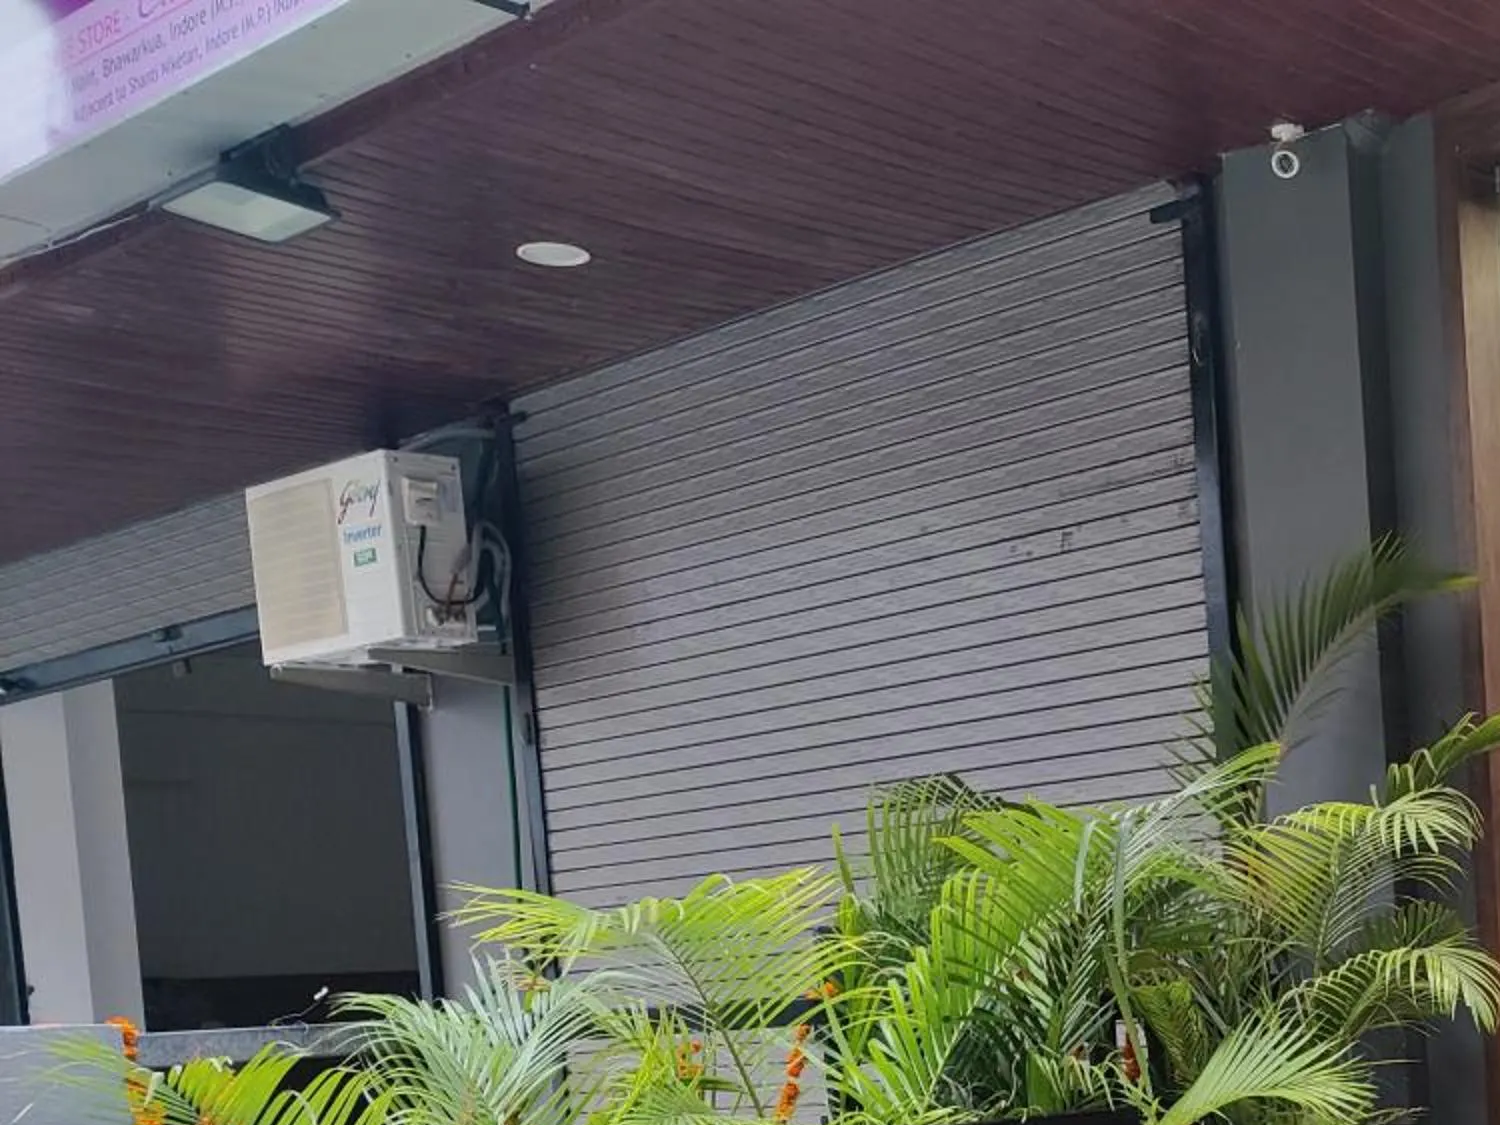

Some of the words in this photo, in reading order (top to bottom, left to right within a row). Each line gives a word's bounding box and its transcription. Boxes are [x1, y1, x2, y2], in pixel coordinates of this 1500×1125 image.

[77, 14, 122, 53] STORE
[169, 9, 207, 40] Indore
[205, 24, 239, 55] Indore
